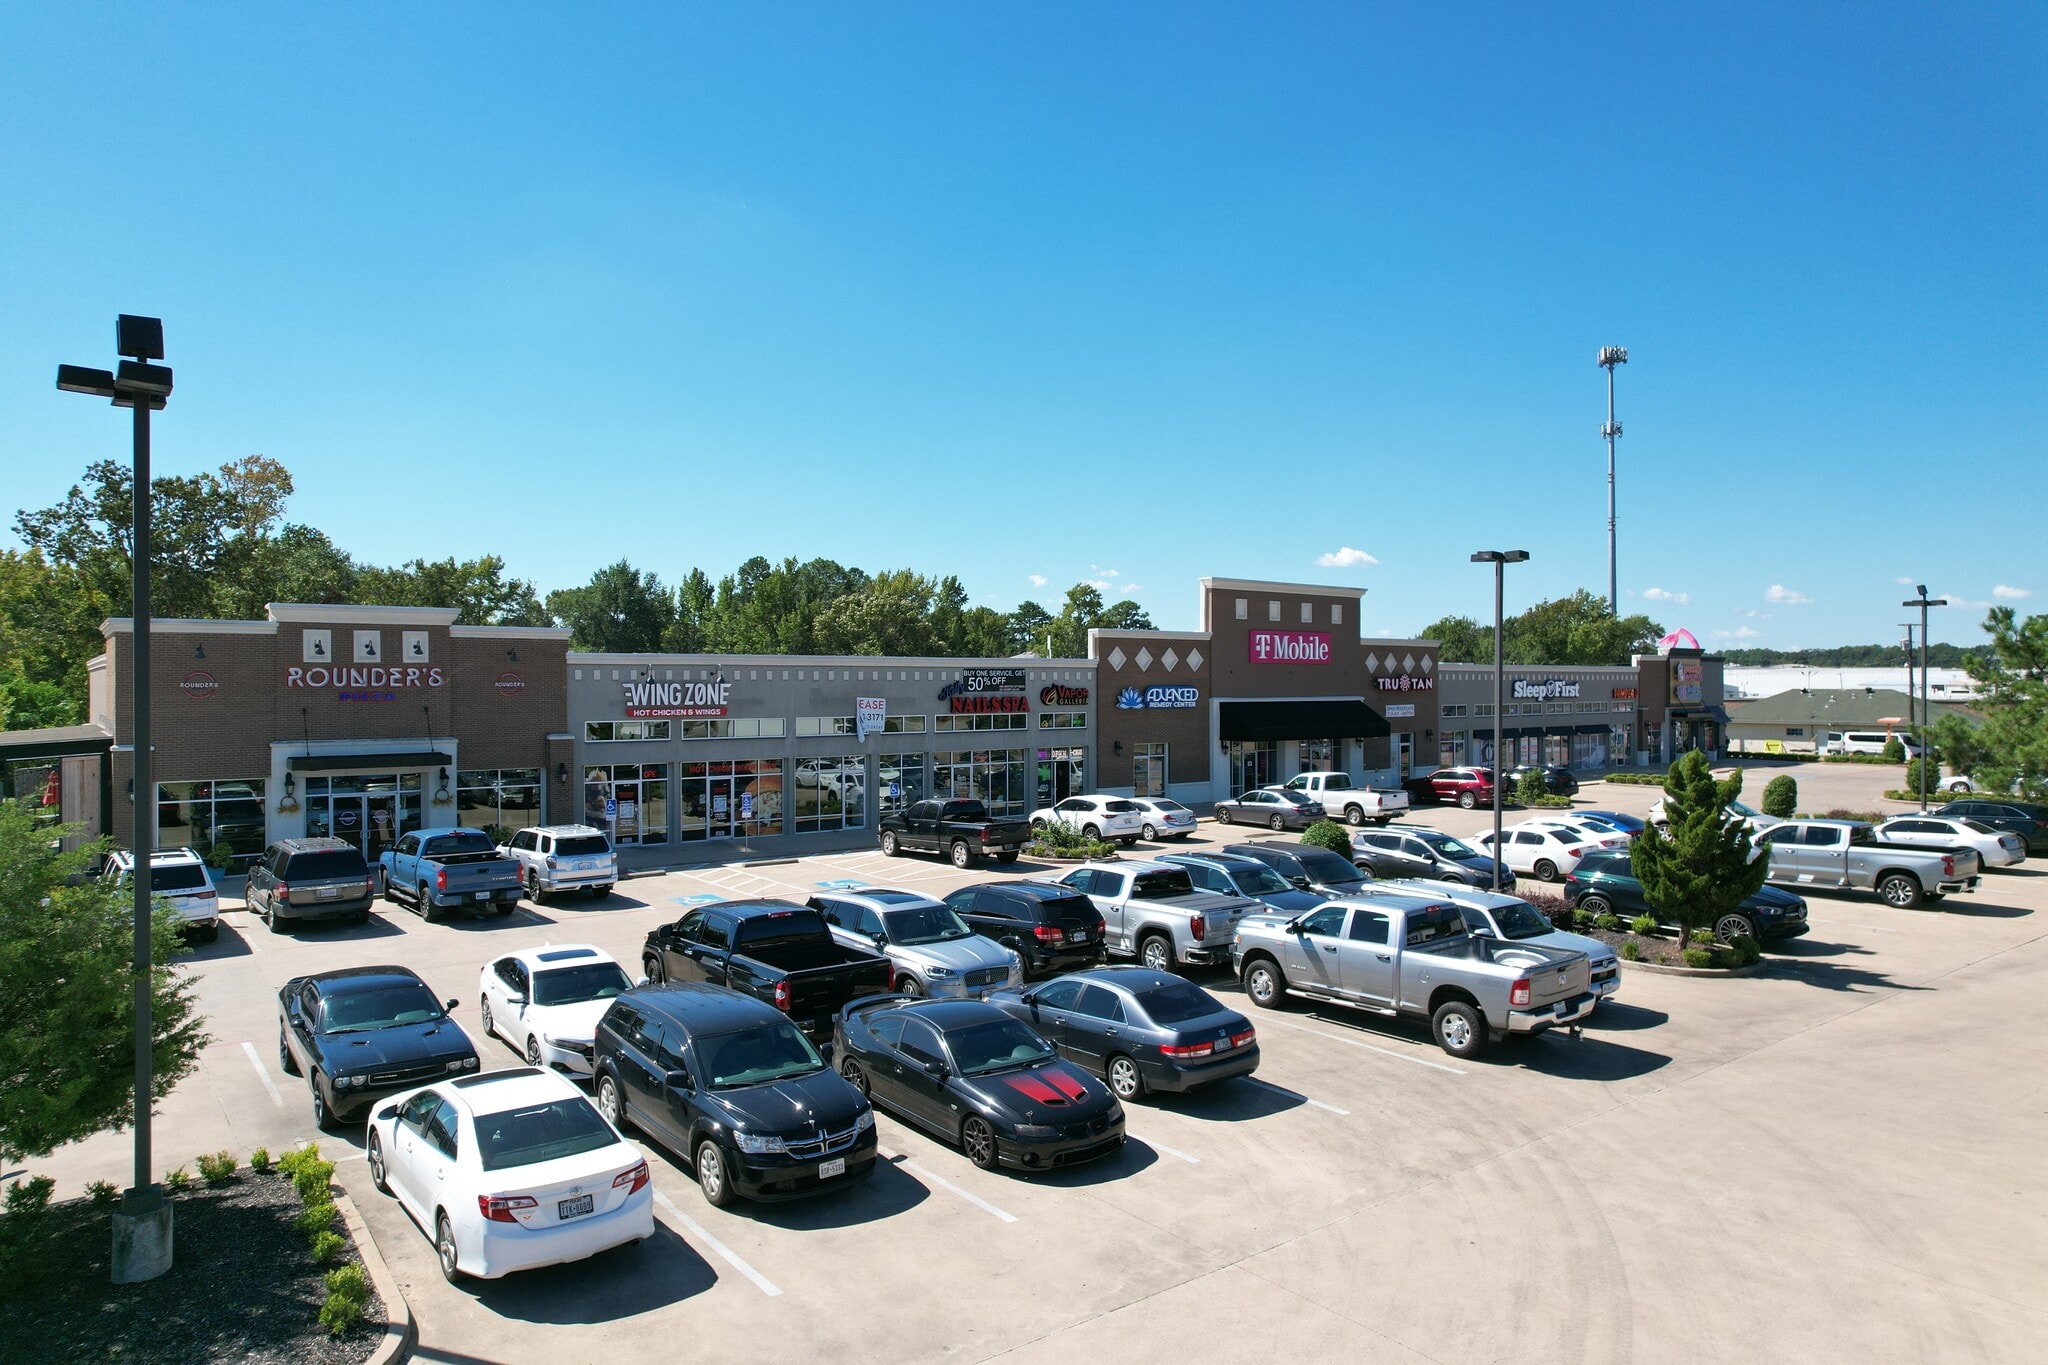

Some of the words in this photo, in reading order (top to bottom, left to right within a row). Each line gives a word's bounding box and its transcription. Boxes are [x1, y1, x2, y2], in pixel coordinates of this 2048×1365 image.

[1273, 635, 1329, 660] Mobile
[286, 667, 444, 688] ROUNDER'S
[963, 669, 976, 677] BUY
[976, 669, 988, 677] ONE
[989, 669, 1014, 677] SERVICE,
[991, 676, 1007, 685] OFF
[1377, 678, 1399, 690] TRU
[1411, 678, 1433, 690] TAN
[339, 691, 397, 702] PIZZA
[622, 683, 682, 706] WING
[1058, 686, 1089, 698] VAPOR
[1147, 688, 1199, 701] ADVANCED
[1514, 680, 1547, 702] Sleep
[1555, 680, 1580, 698] First
[950, 697, 1000, 713] NAILS
[1002, 696, 1030, 713] SPA
[652, 708, 687, 716] CHICKEN
[688, 708, 693, 716] &
[695, 708, 721, 716] WINGS
